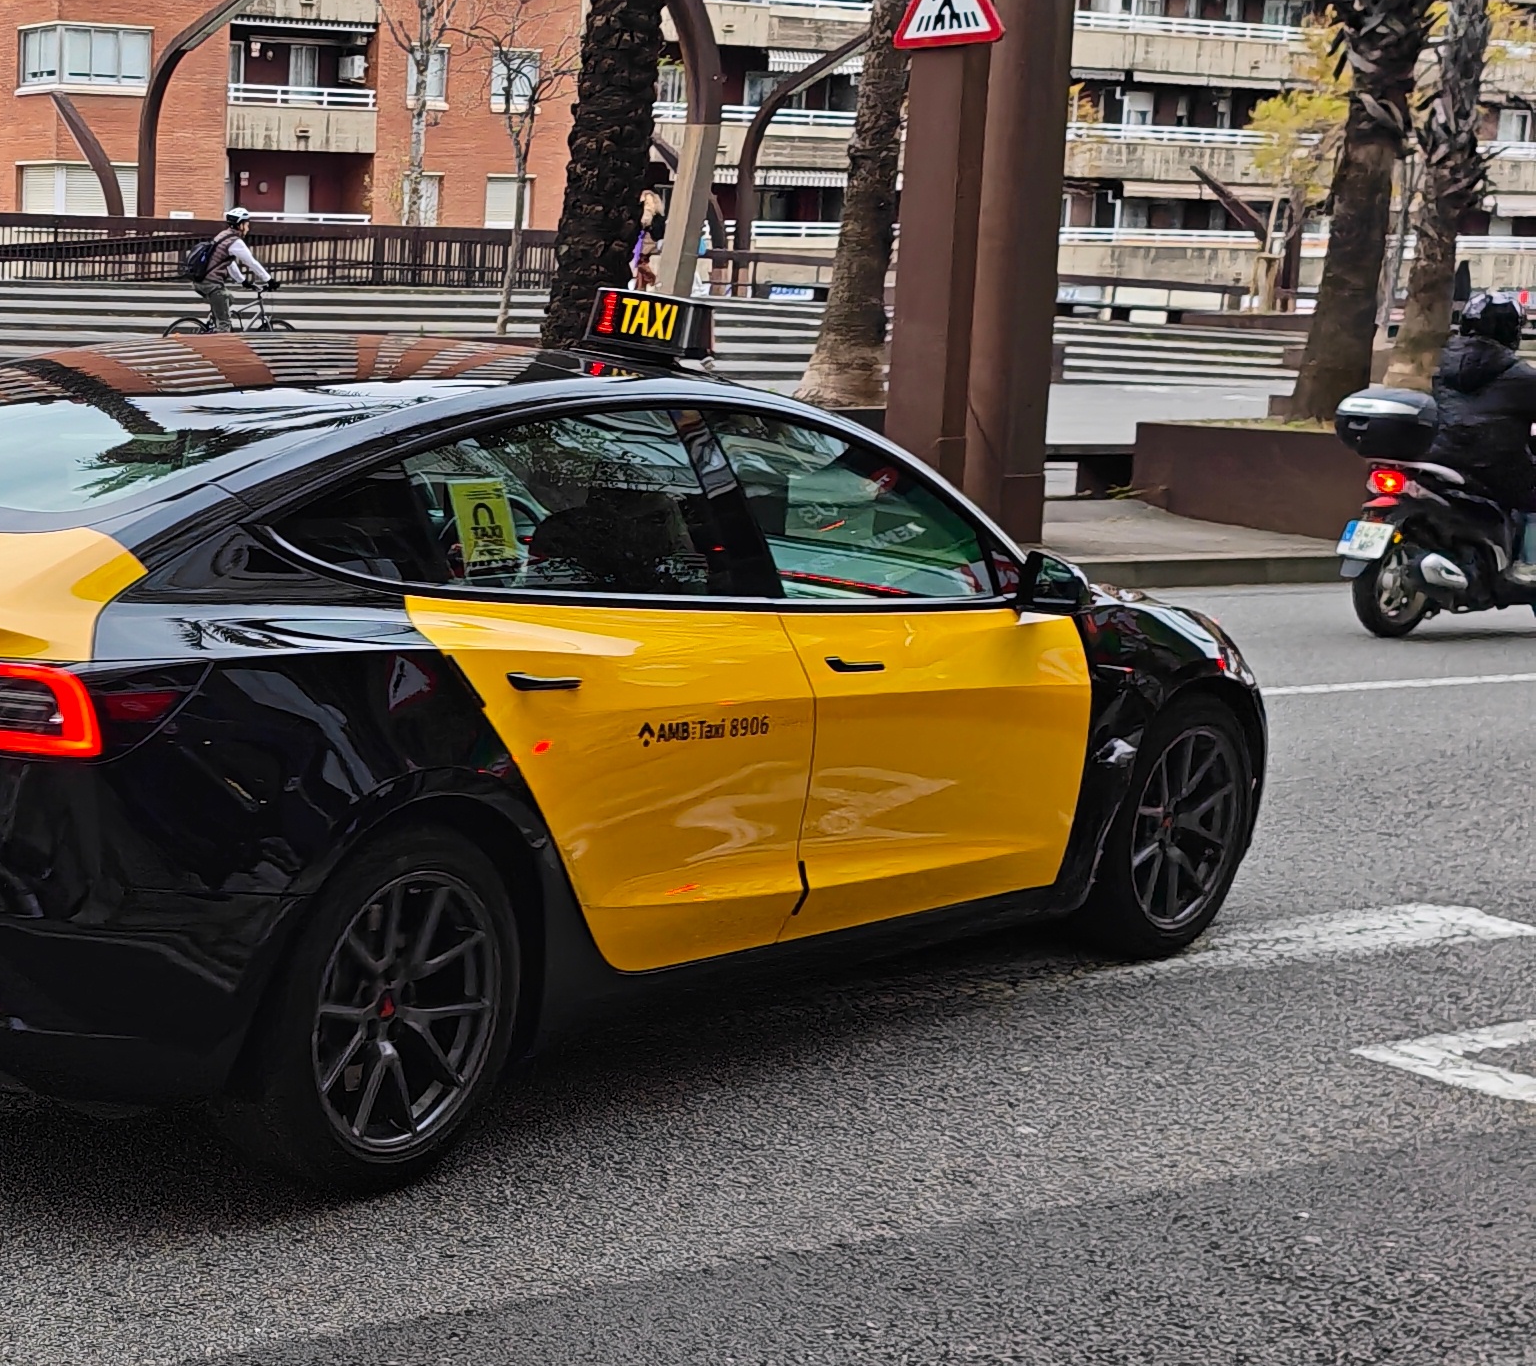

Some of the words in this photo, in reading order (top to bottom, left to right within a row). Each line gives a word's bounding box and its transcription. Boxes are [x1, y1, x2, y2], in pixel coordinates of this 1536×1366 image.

[620, 297, 679, 341] TAXI
[697, 717, 726, 740] Taxi
[728, 715, 771, 738] 8906
